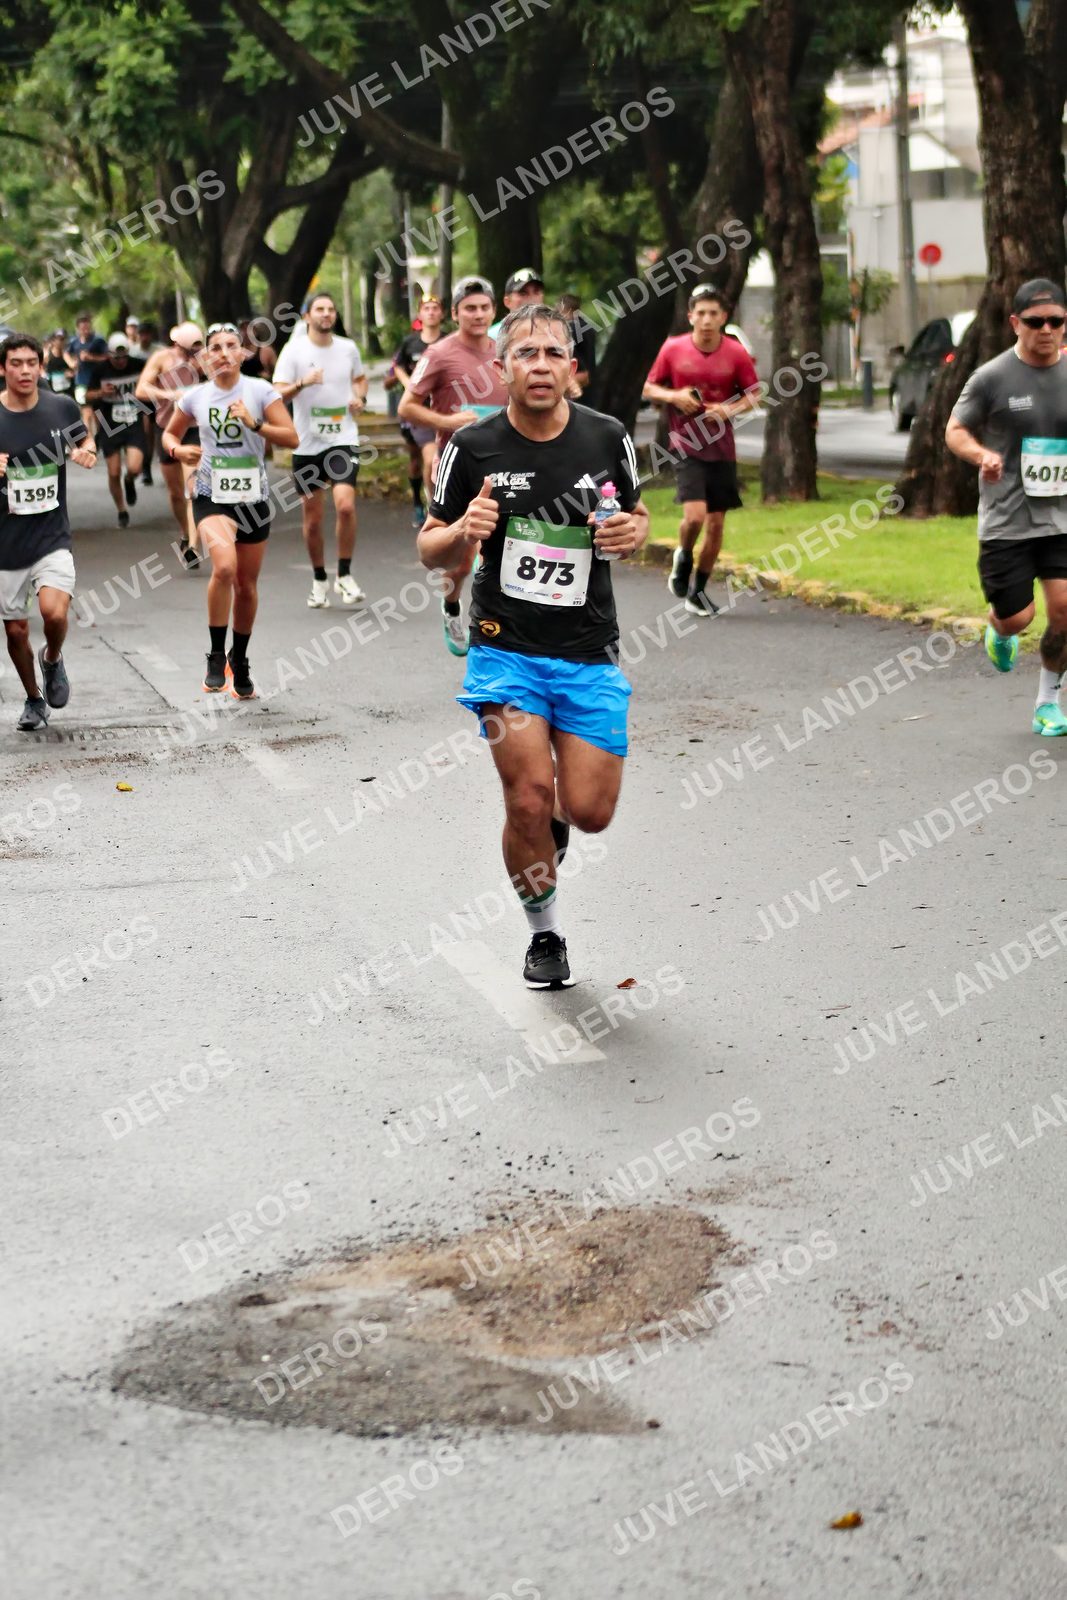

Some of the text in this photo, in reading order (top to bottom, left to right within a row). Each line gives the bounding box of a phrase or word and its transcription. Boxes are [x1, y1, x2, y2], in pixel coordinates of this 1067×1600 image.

[210, 423, 242, 440] YO
[318, 423, 341, 434] 733
[219, 477, 252, 491] 823
[14, 484, 55, 503] 1395
[516, 555, 576, 587] 873
